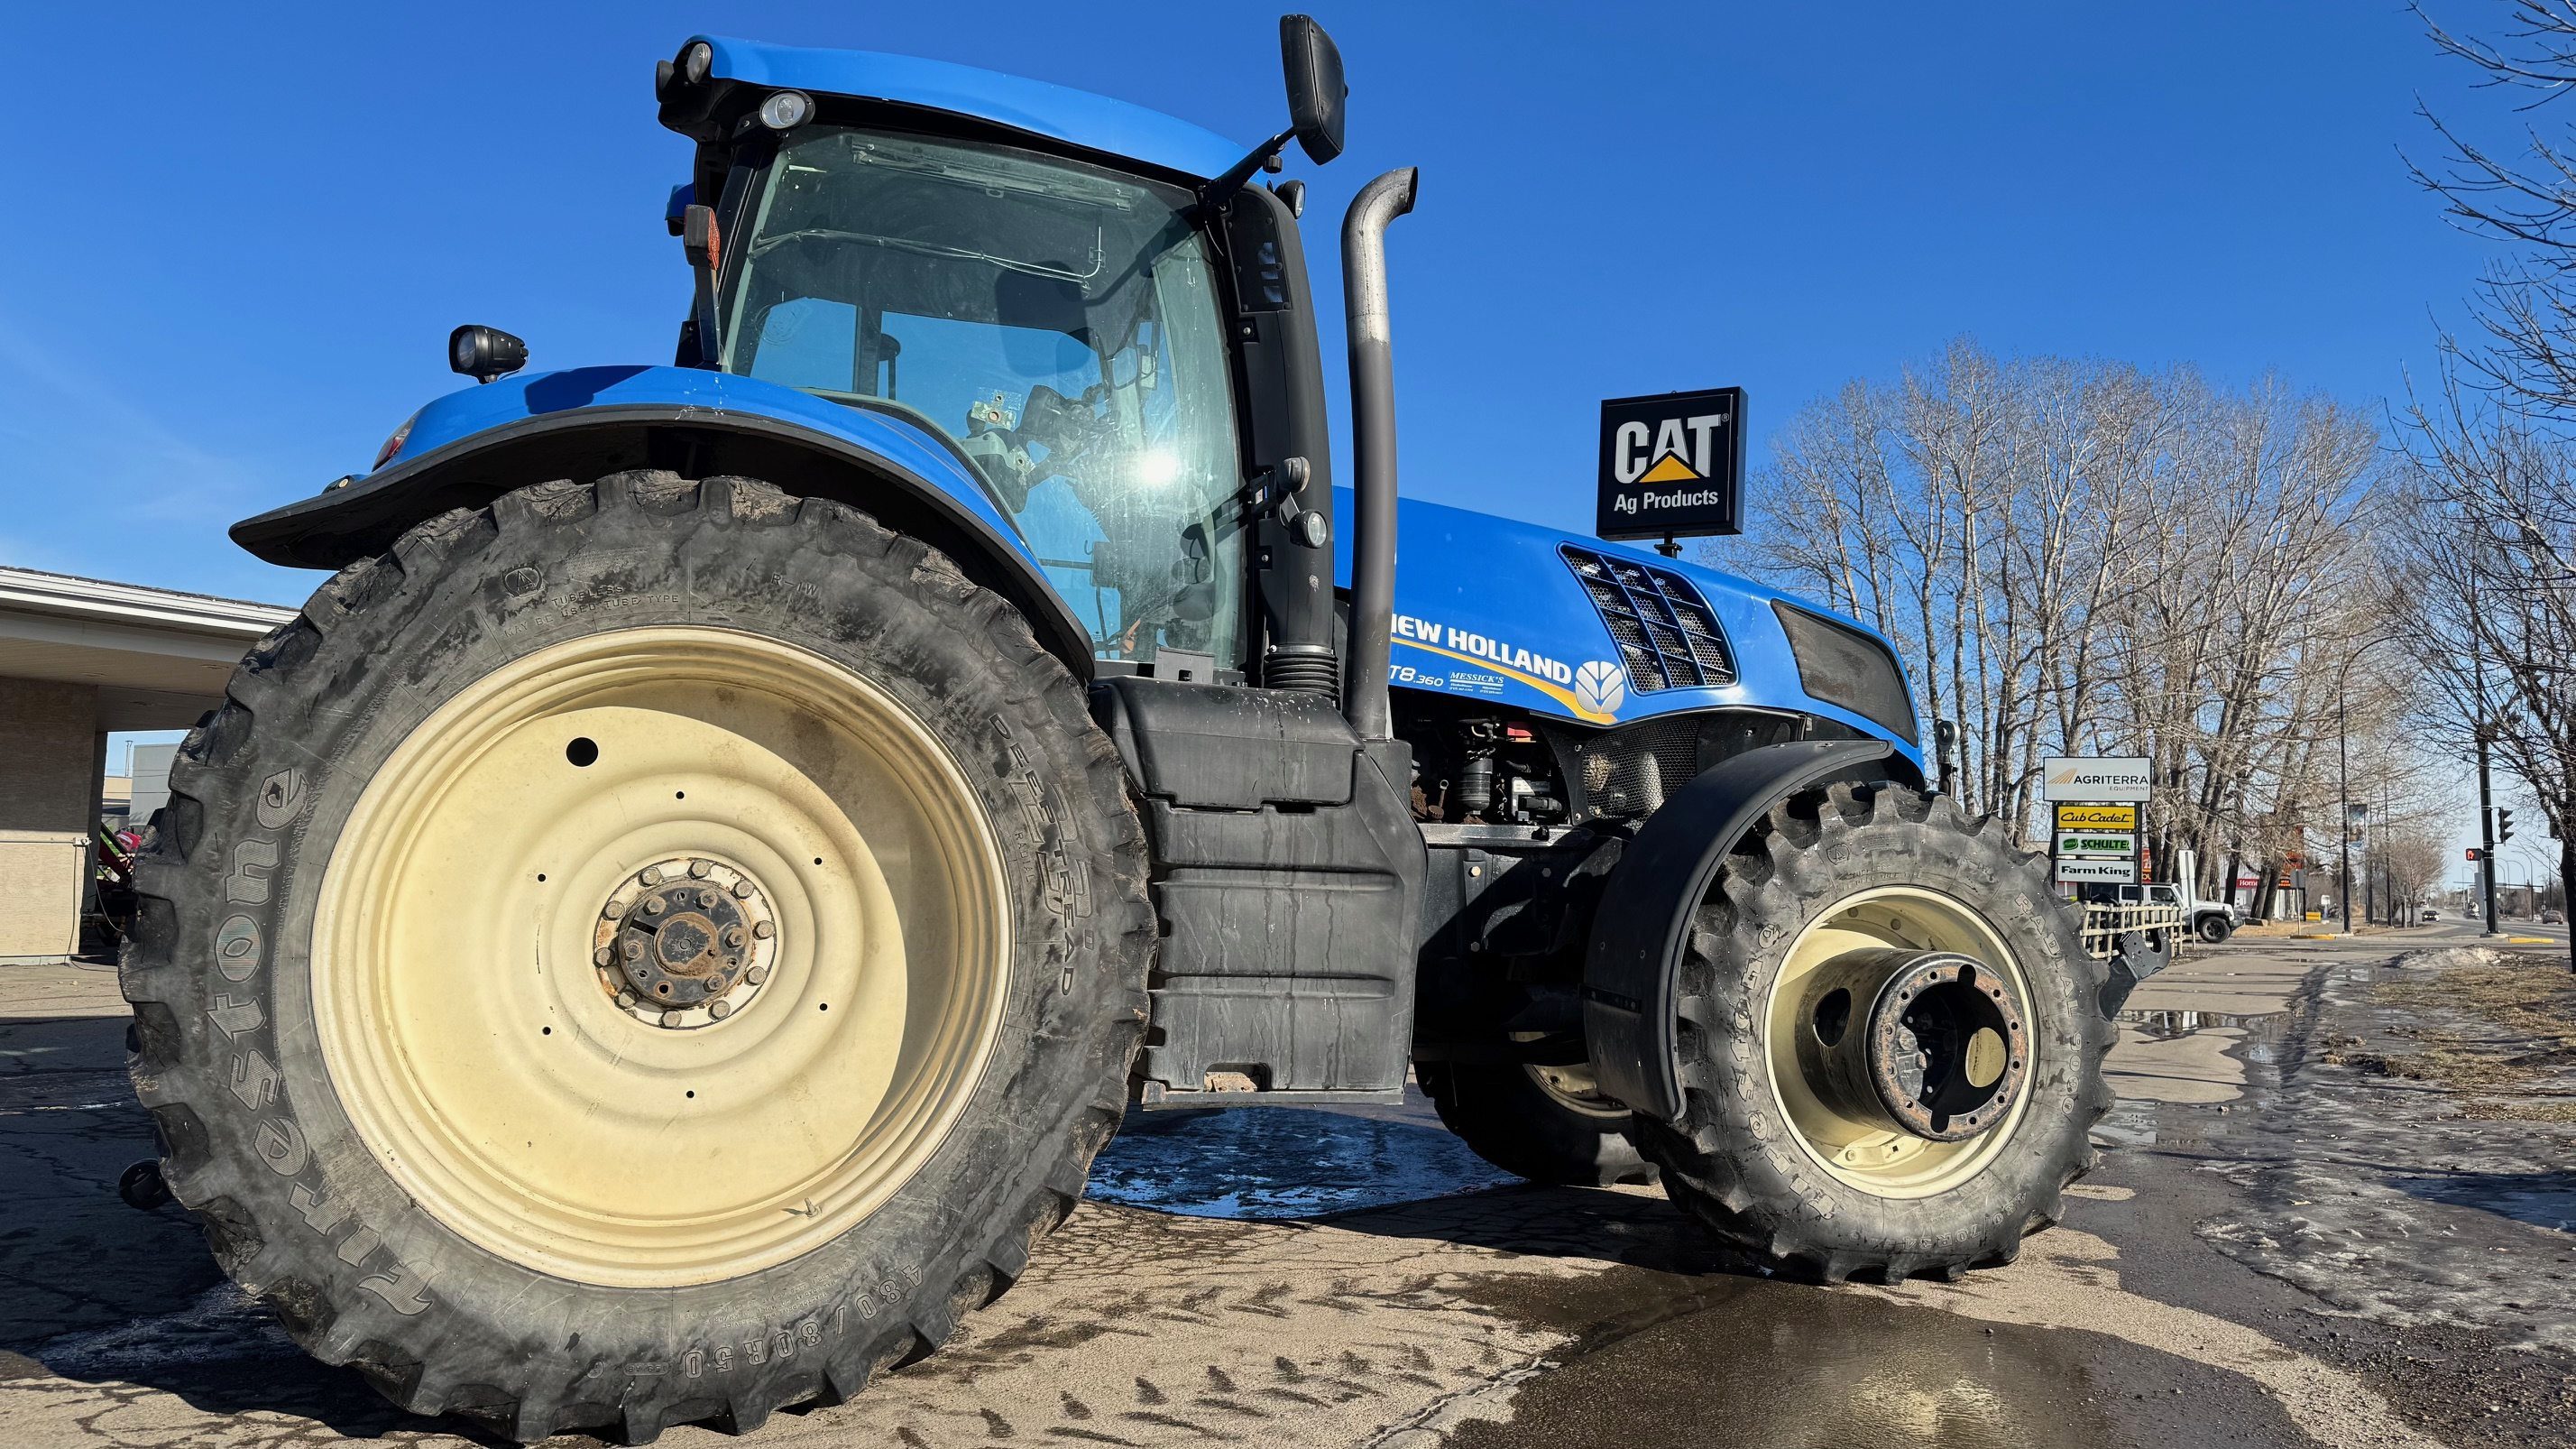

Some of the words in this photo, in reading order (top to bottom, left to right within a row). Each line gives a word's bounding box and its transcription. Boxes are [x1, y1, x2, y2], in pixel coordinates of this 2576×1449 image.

[1614, 494, 1637, 514] Ag
[1643, 490, 1719, 510] Products
[551, 586, 625, 606] TUBELESS
[561, 603, 596, 618] USED
[603, 596, 641, 609] TUBE
[647, 594, 679, 604] TYPE
[1448, 627, 1572, 685] HOLLAND
[1449, 671, 1504, 684] MESSICK'S
[2074, 775, 2148, 785] AGRITERRA
[2060, 812, 2086, 822] Cub
[2088, 813, 2132, 823] Cadet
[989, 713, 1056, 824] DEEP
[1054, 838, 1075, 996] TREAD
[2080, 839, 2130, 851] SCHULTE
[1015, 832, 1035, 883] RADIAL
[2061, 865, 2096, 874] Farm
[2098, 866, 2130, 878] King
[2015, 891, 2078, 1018] RADIAL
[207, 767, 443, 1315] Firestone
[682, 1264, 924, 1380] 480/80R50
